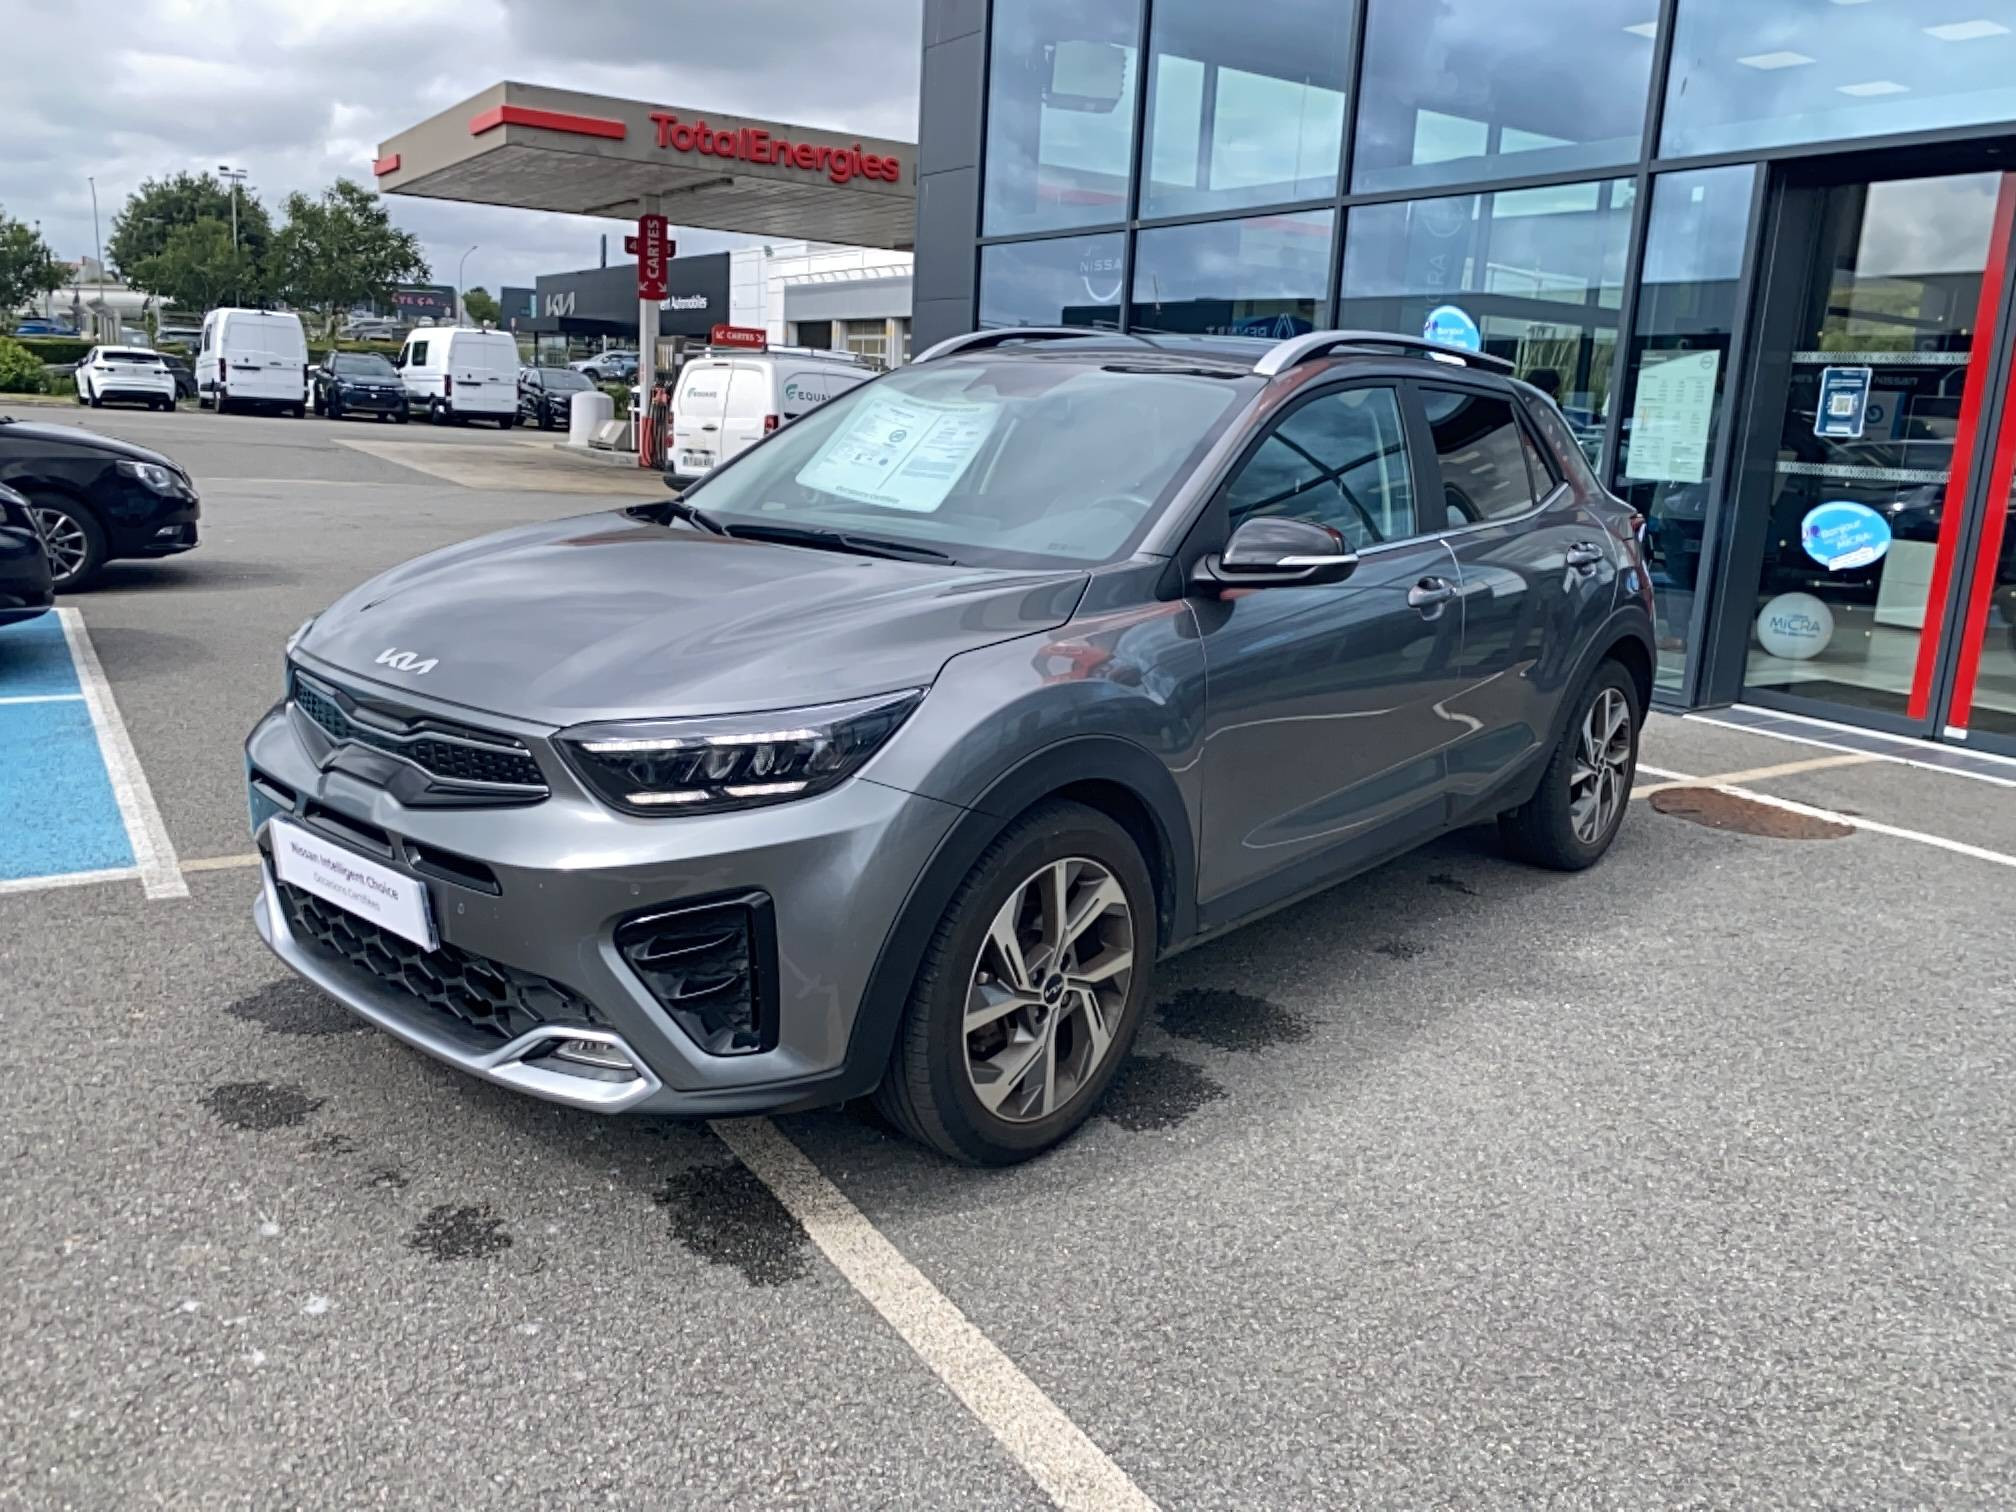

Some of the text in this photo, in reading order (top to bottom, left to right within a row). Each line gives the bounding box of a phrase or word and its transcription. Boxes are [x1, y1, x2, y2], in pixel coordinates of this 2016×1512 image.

[649, 111, 900, 183] TotalEnergies
[647, 219, 660, 279] CARTES
[1079, 257, 1123, 273] NISSA
[726, 331, 756, 342] CARTES
[289, 840, 400, 901] Nissan Intelligent Choice
